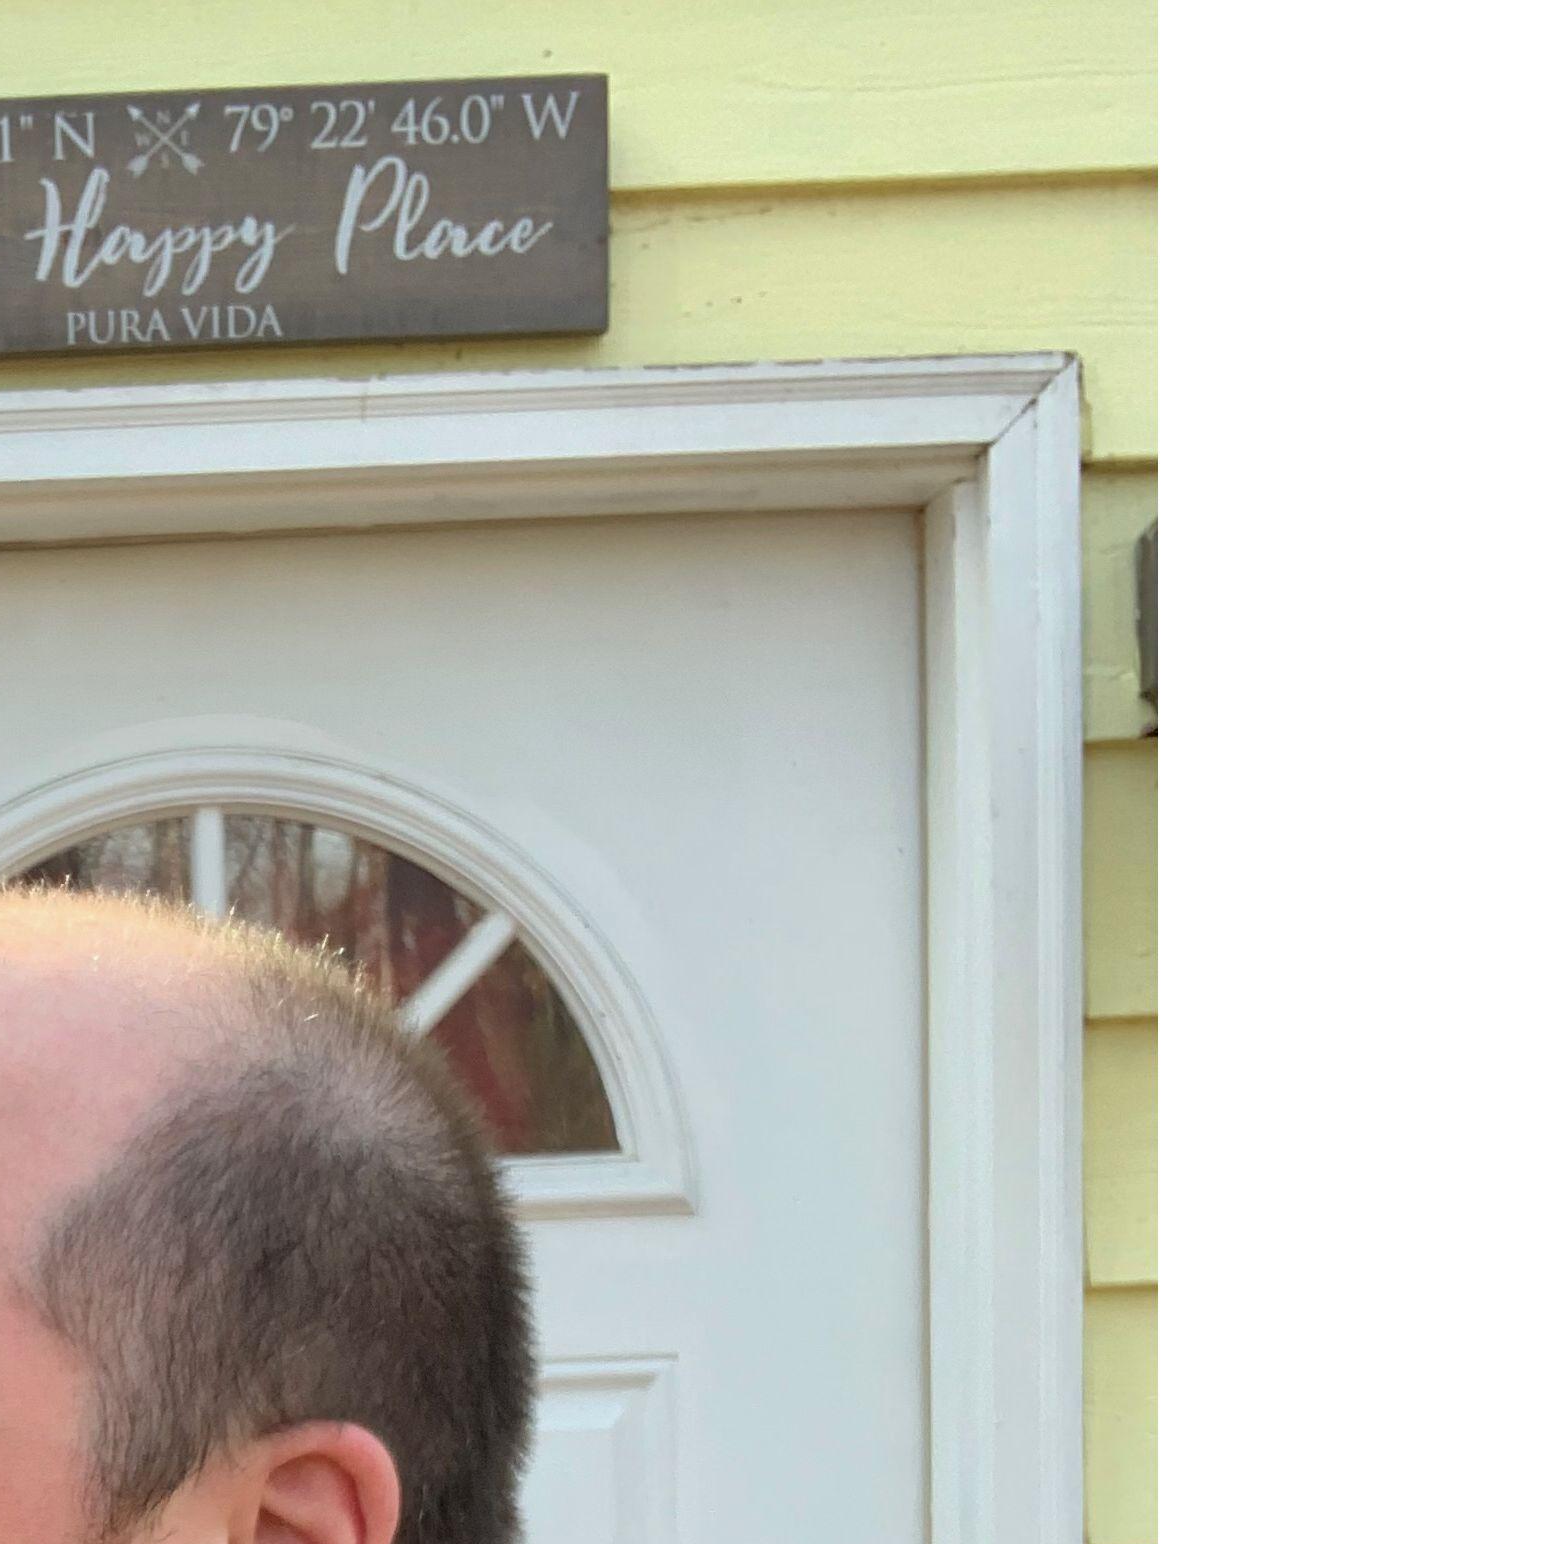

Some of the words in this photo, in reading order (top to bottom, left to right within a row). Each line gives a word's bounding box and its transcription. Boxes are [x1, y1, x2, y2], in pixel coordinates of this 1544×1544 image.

[53, 111, 96, 161] N
[309, 99, 376, 149] 22'
[520, 90, 580, 140] W
[23, 167, 294, 298] Happy
[334, 155, 553, 275] Place
[66, 308, 172, 346] PURA
[180, 303, 284, 340] VIDA
